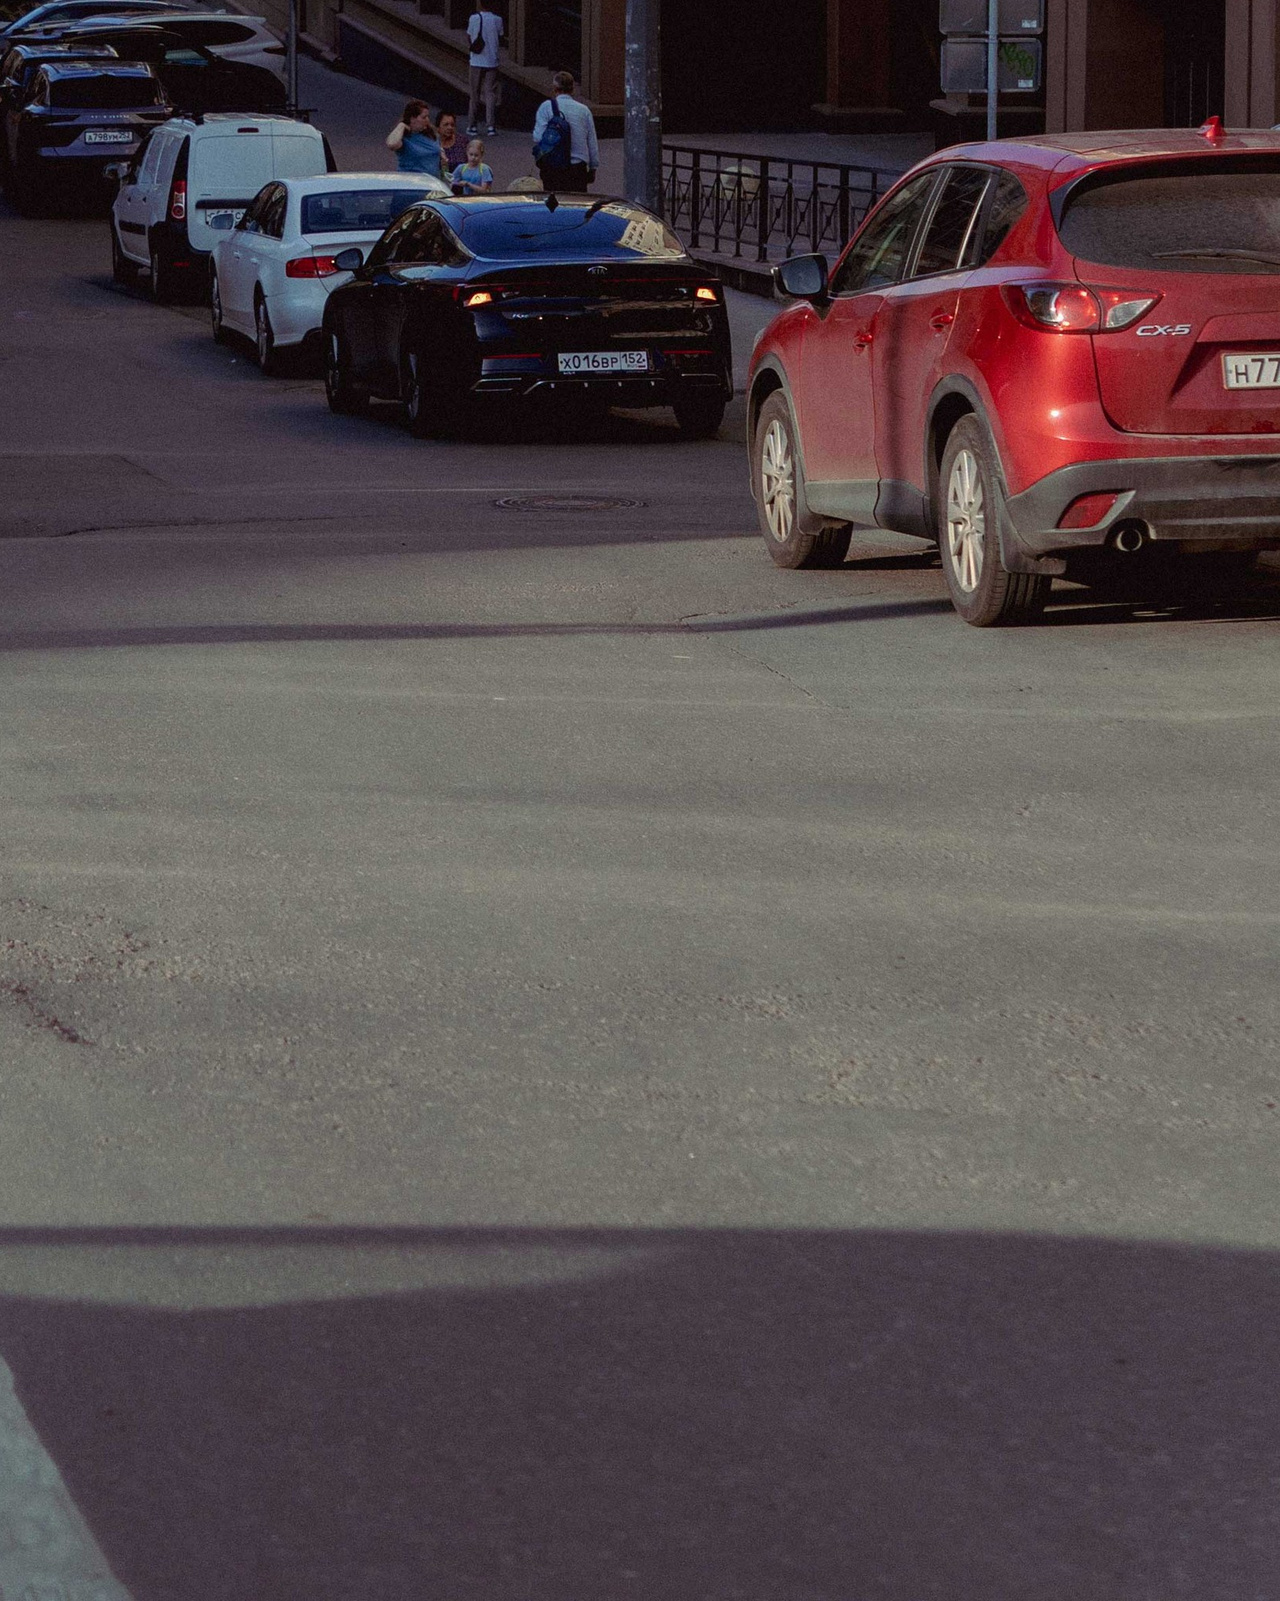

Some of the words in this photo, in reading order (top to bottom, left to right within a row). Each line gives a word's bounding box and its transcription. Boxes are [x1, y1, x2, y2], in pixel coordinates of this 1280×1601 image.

[1135, 324, 1192, 336] CX-5
[563, 355, 619, 369] Х016ВР
[622, 353, 643, 364] 152
